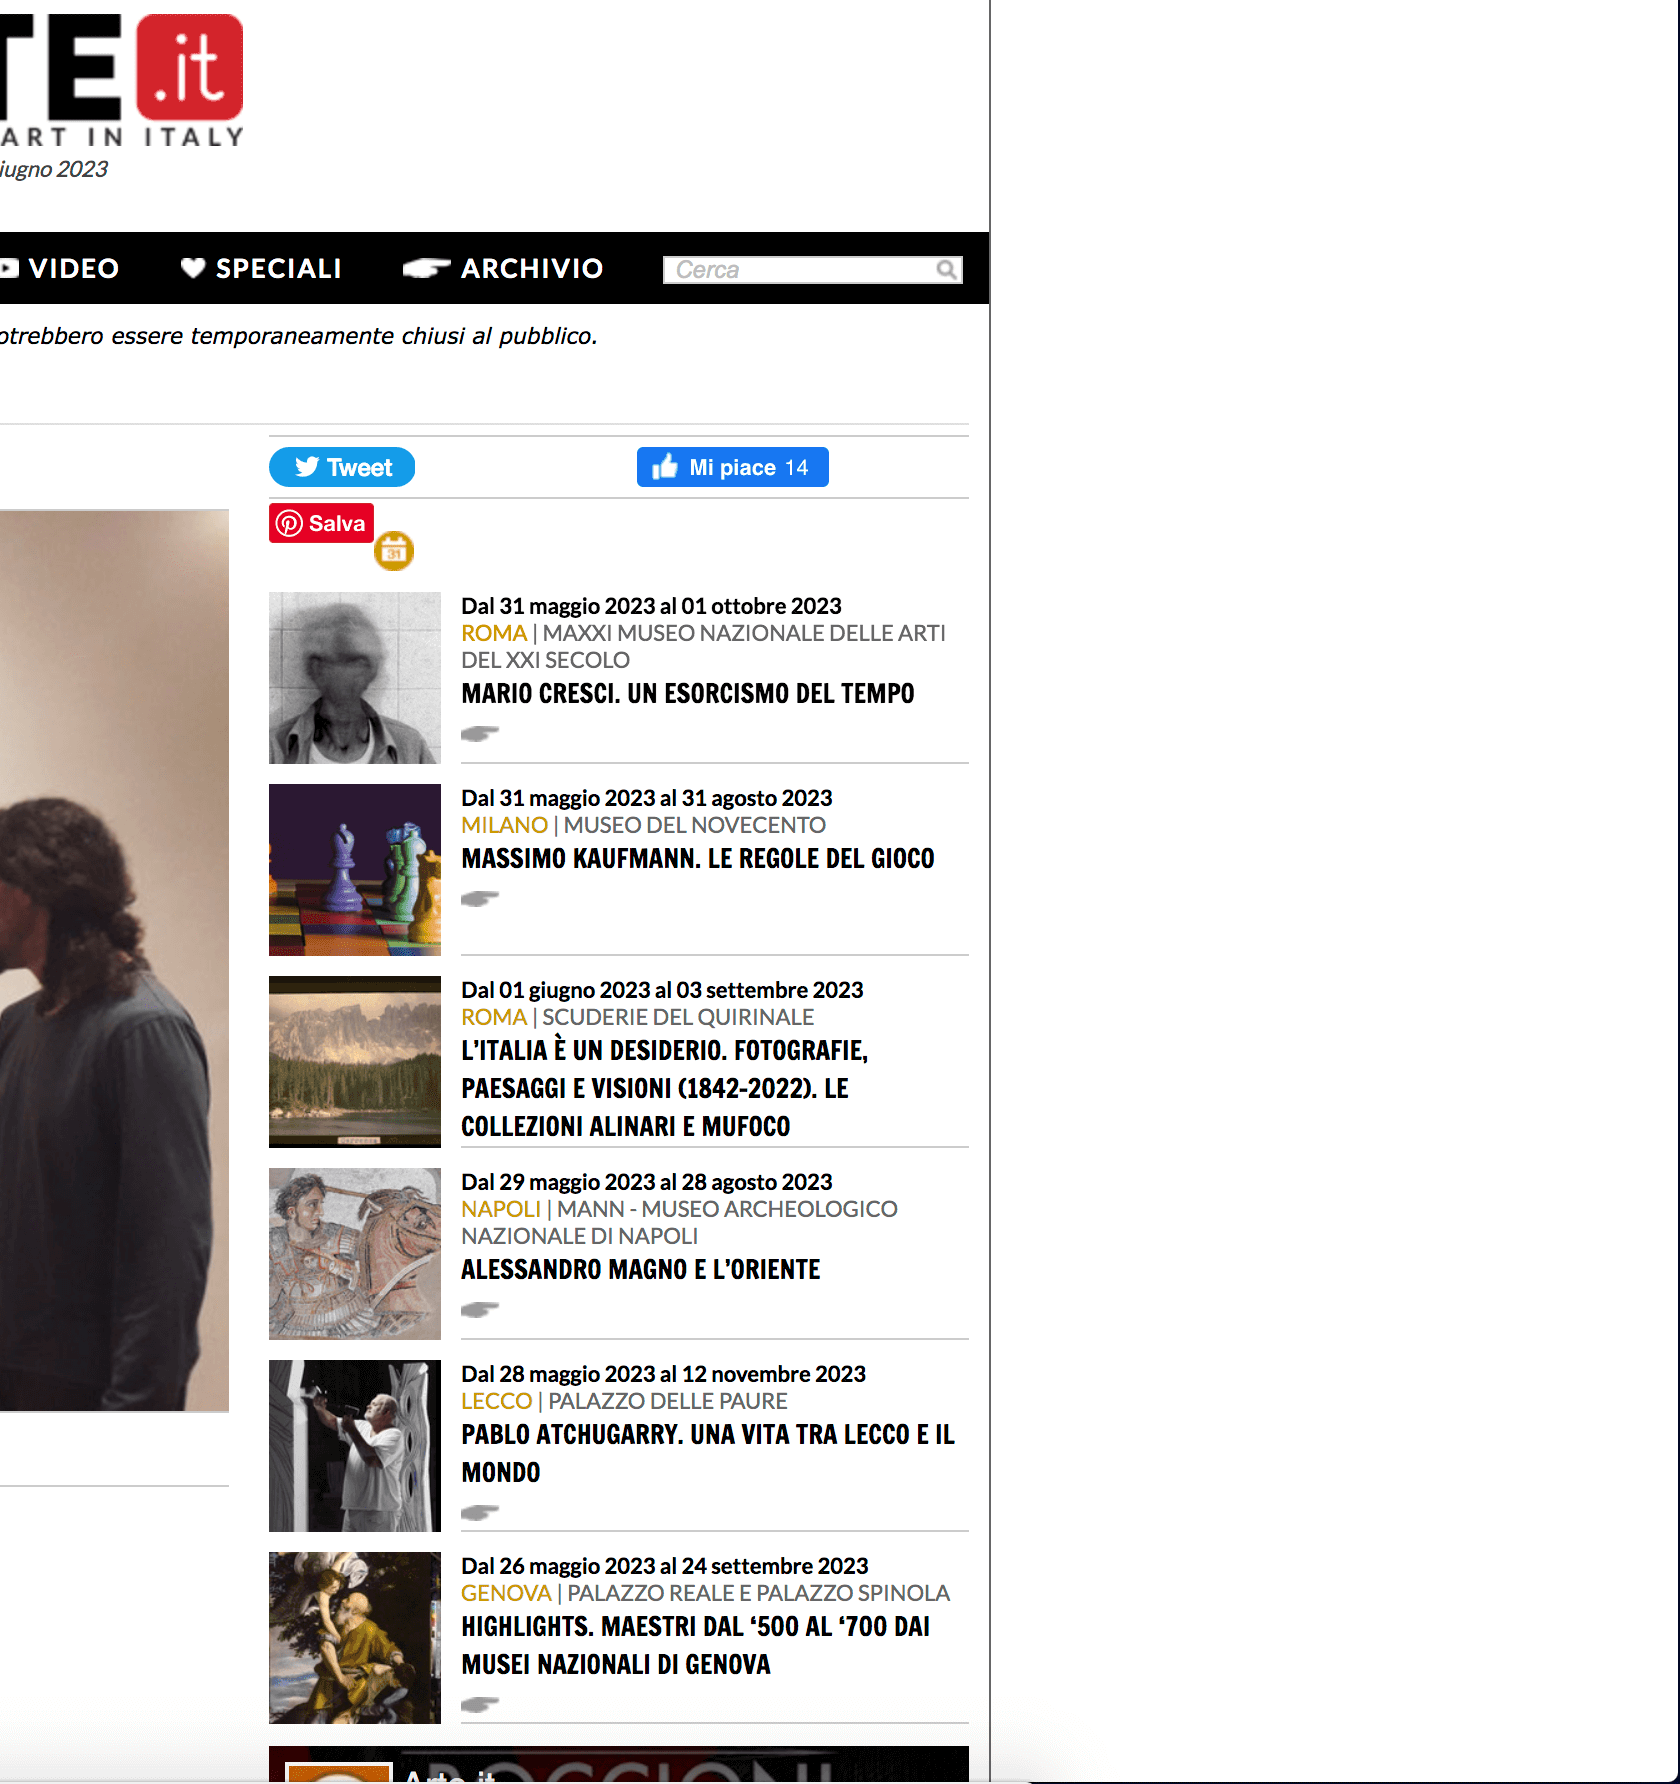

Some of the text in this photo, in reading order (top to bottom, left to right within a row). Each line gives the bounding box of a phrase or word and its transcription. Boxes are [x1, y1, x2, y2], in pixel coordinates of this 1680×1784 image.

[0, 127, 66, 146] ART
[89, 127, 122, 146] IN
[145, 127, 243, 146] ITALY
[56, 160, 109, 177] 2023
[28, 258, 118, 279] VIDEO
[216, 258, 340, 279] SPECIALI
[461, 258, 603, 279] ARCHIVIO
[677, 260, 739, 278] Cerca
[112, 331, 183, 344] essere
[192, 328, 394, 349] temporaneamente
[402, 327, 466, 344] chiusi
[472, 327, 493, 344] al
[499, 327, 596, 349] pubblico.
[327, 458, 393, 477] Tweet
[691, 459, 808, 480] Mi piace 14
[309, 515, 365, 532] Salva
[462, 597, 841, 618] Dal 31 maggio 2023 al 01 ottobre 2023
[463, 624, 944, 641] ROMA MAXXI MUSEO NAZIONALE DELLE ARTI
[463, 682, 914, 703] MARIO CRESCI. UN ESORCISMO DEL TEMPO
[462, 816, 826, 833] MILANO MUSEO DEL NOVECENTO
[462, 847, 934, 868] MASSIMO KAUFMANN. LE REGOLE DEL GIOCO
[462, 981, 863, 1002] Dal 01 giugno 2023 al 03 settembre 2023
[554, 1032, 566, 1060] È
[574, 1040, 602, 1060] UN
[611, 1039, 727, 1060] DESIDERIO.
[735, 1039, 868, 1064] FOTOGRAFIE,
[462, 1077, 849, 1099] PAESAGGI E VISIONI (1842-2022). LE
[462, 1200, 898, 1217] NAPOLI MANN MUSEO ARCHEOLOGICO
[461, 1258, 601, 1279] ALESSANDRO
[609, 1258, 687, 1279] MAGNO
[695, 1259, 706, 1279] E
[462, 1423, 955, 1444] PABLO ATCHUGARRY. UNA VITA TRA LECCO E IL
[462, 1461, 540, 1482] MONDO
[461, 1584, 951, 1601] GENOVA PALAZZO REALE E PALAZZO SPINOLA
[462, 1615, 594, 1636] HIGHLIGHTS.
[602, 1615, 695, 1636] MAESTRI
[704, 1616, 744, 1636] DAL
[805, 1616, 833, 1636] AL
[895, 1616, 929, 1636] DAI
